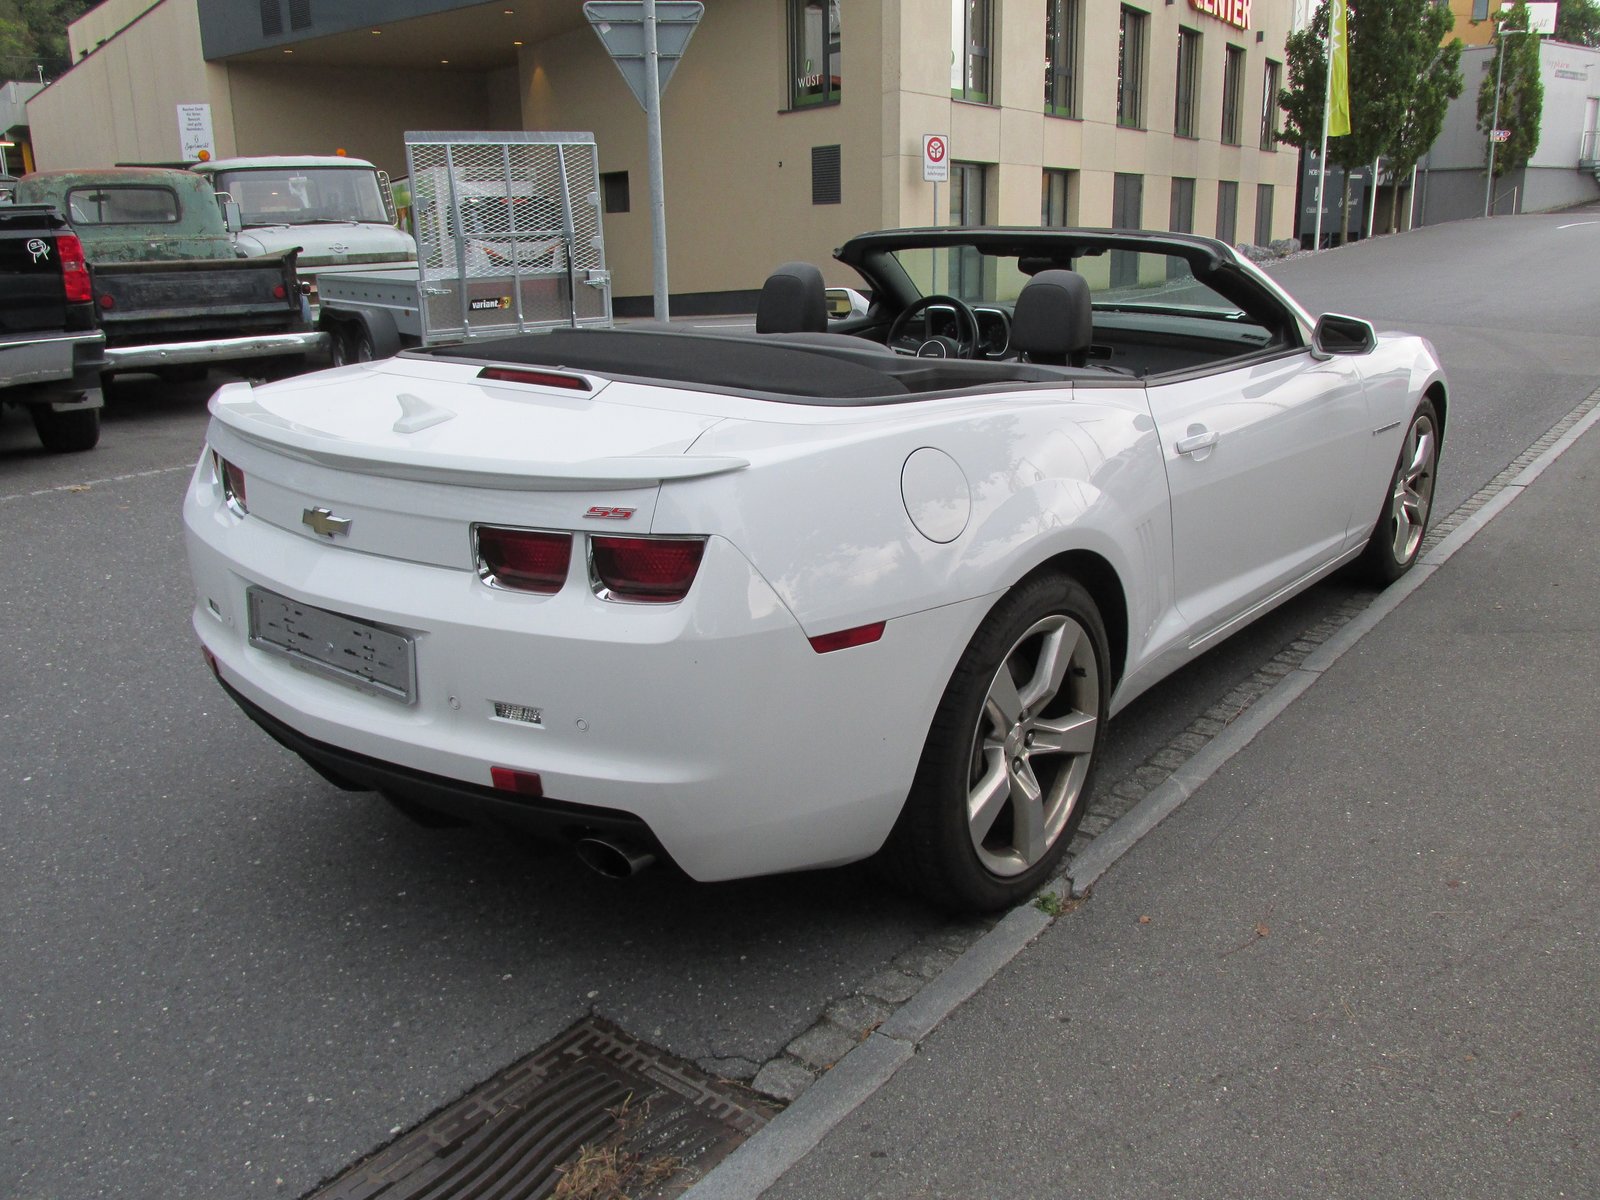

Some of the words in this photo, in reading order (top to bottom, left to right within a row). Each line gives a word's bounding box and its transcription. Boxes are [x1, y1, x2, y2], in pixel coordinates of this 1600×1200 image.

[1190, 0, 1251, 30] NTER
[472, 300, 498, 309] variant
[582, 506, 637, 520] SS
